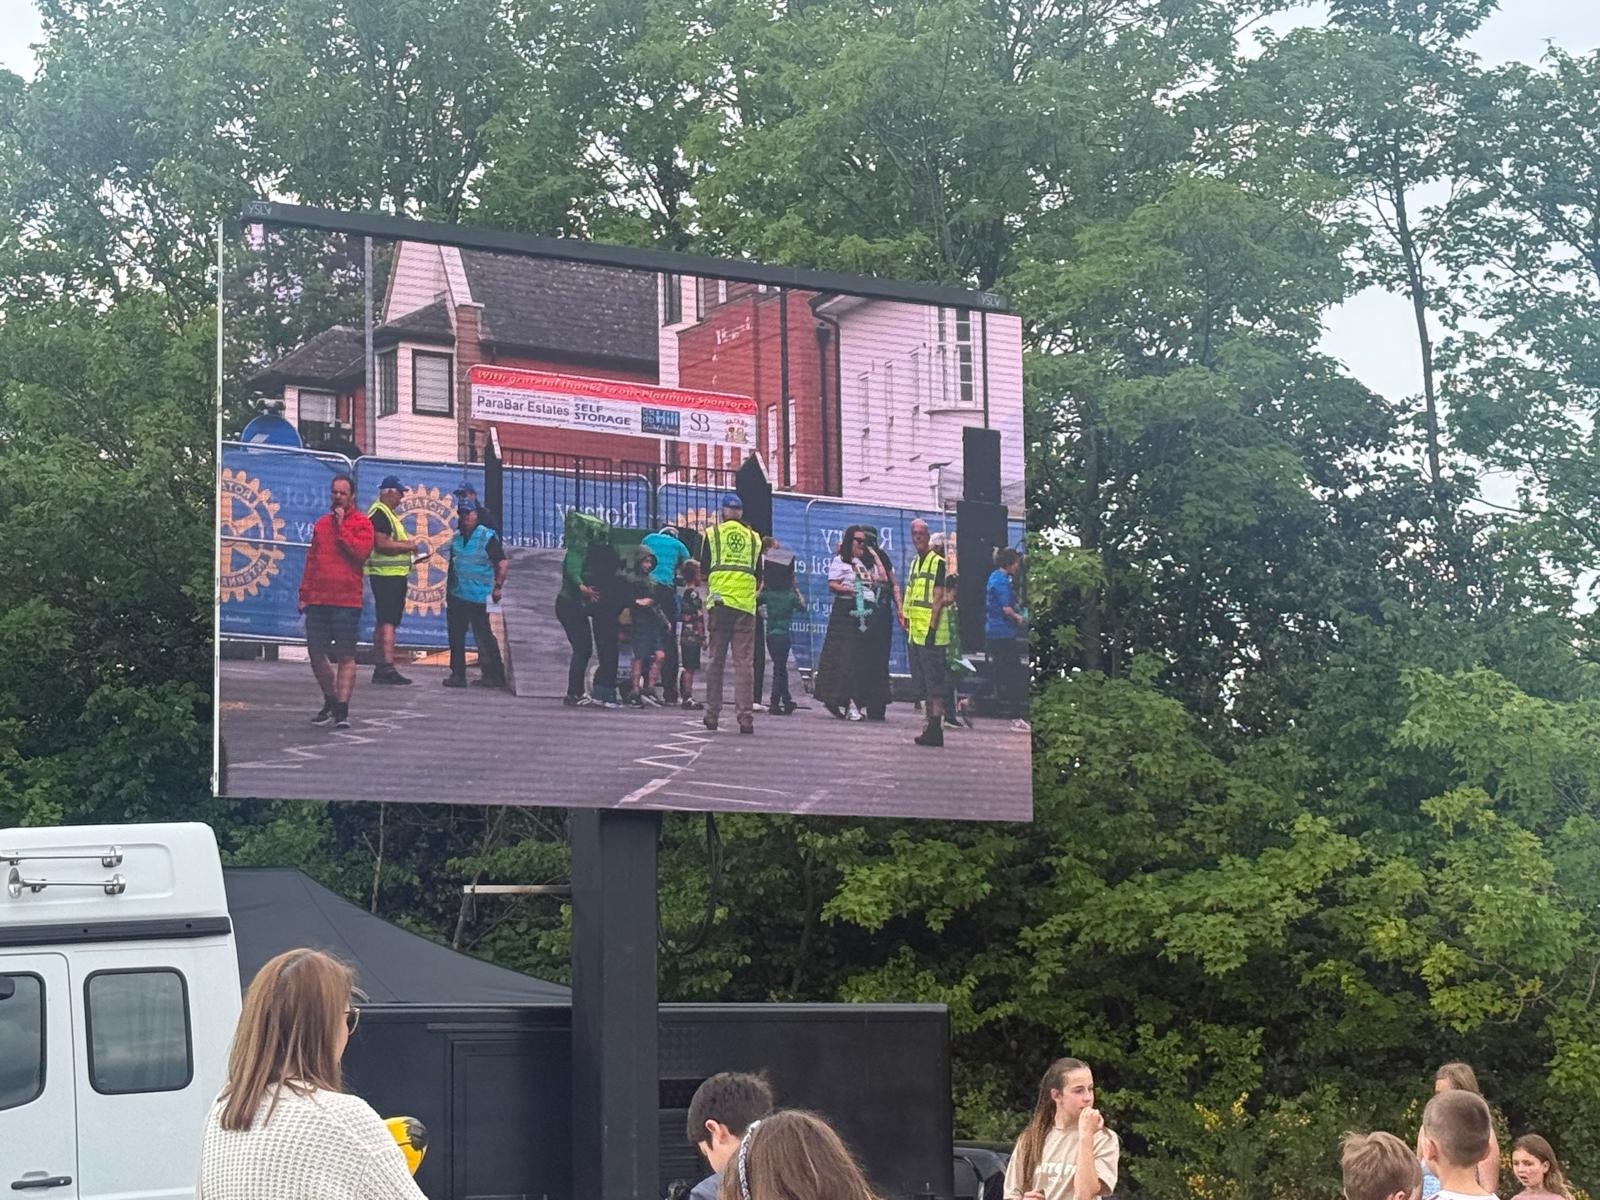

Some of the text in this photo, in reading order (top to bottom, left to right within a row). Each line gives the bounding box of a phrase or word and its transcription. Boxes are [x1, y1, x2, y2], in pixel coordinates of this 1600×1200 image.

[477, 370, 506, 381] With
[641, 389, 695, 403] Platinum
[477, 395, 524, 411] ParaBar
[527, 401, 570, 416] Estates
[574, 402, 604, 413] SELF
[574, 412, 633, 426] STORAGE
